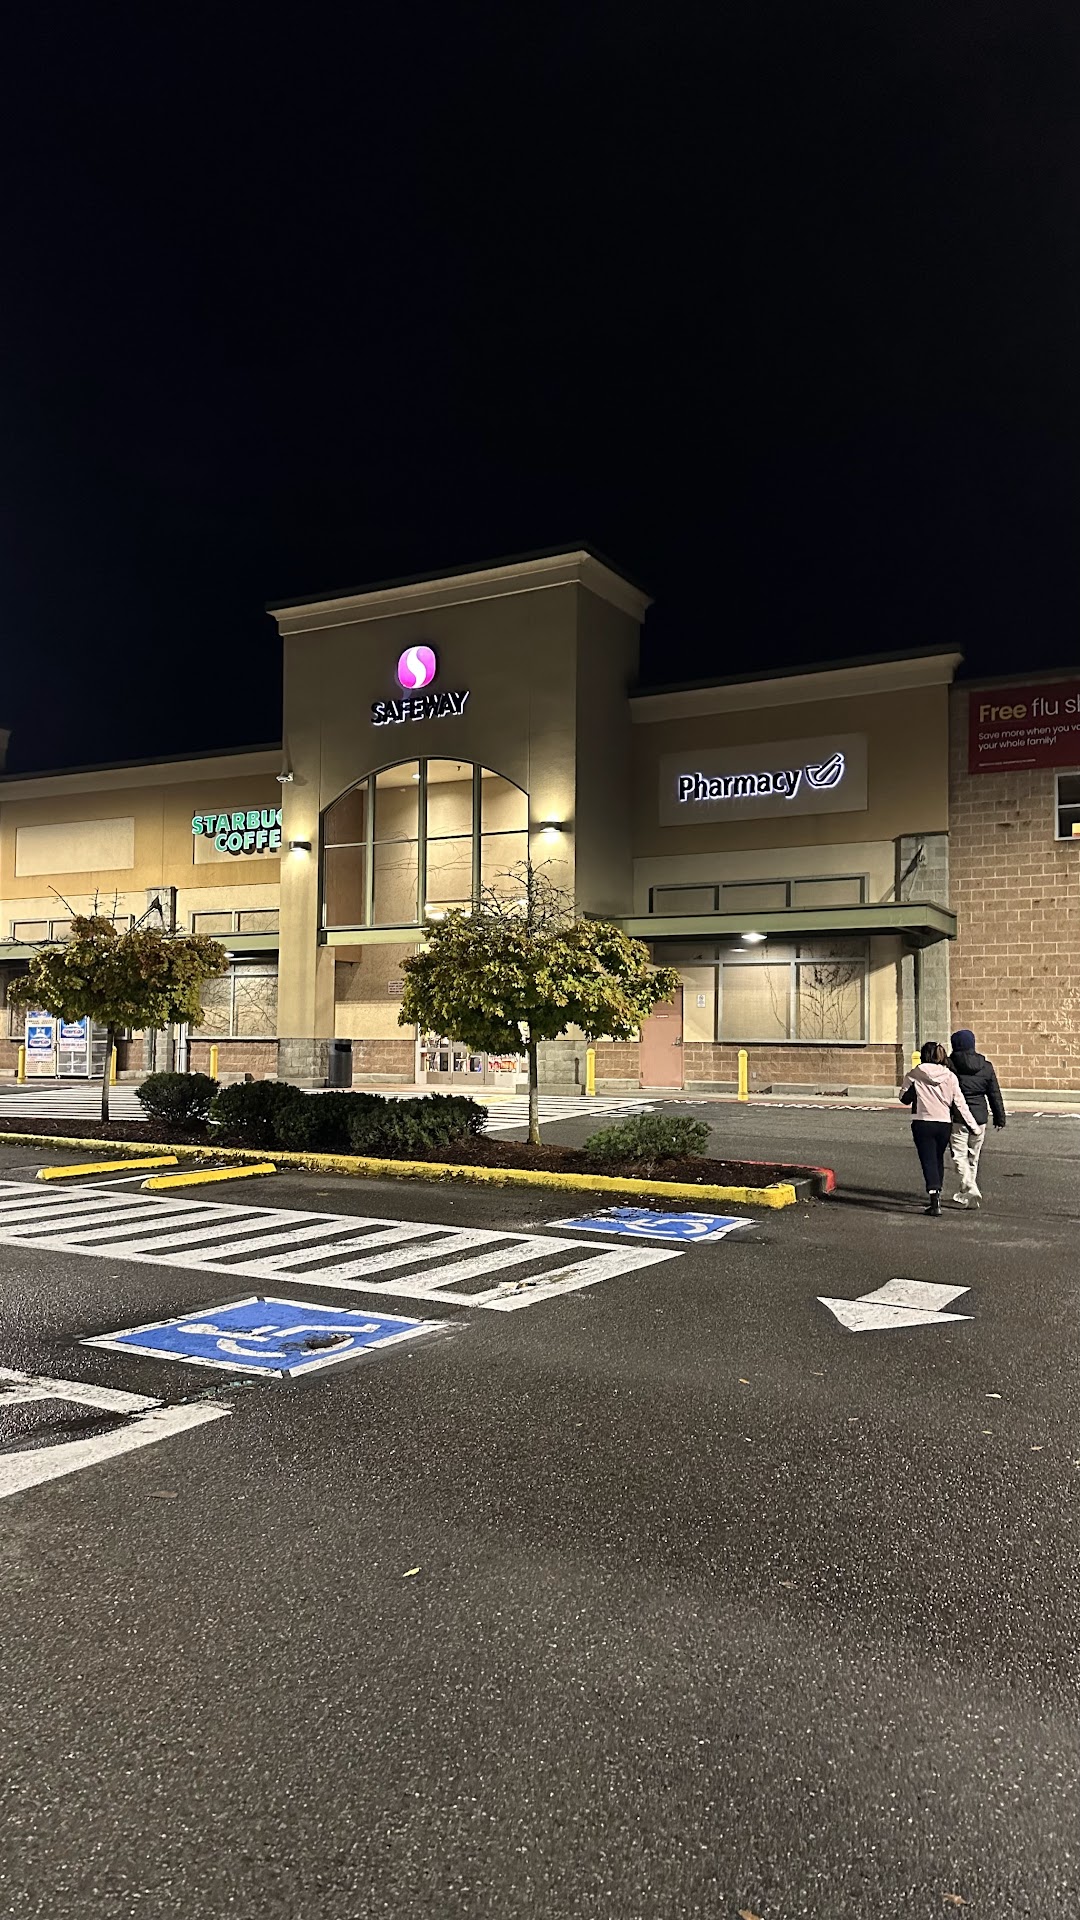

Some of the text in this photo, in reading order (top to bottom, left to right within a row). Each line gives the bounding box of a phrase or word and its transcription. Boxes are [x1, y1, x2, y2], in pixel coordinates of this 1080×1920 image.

[371, 690, 470, 726] SAFEWAY
[979, 704, 1028, 722] Free
[1032, 697, 1059, 717] flu
[978, 732, 1000, 740] Save
[1001, 729, 1025, 738] more
[1026, 726, 1051, 735] when
[1053, 725, 1070, 735] you
[978, 735, 1057, 752] your whole family!
[679, 769, 802, 802] Pharmacy
